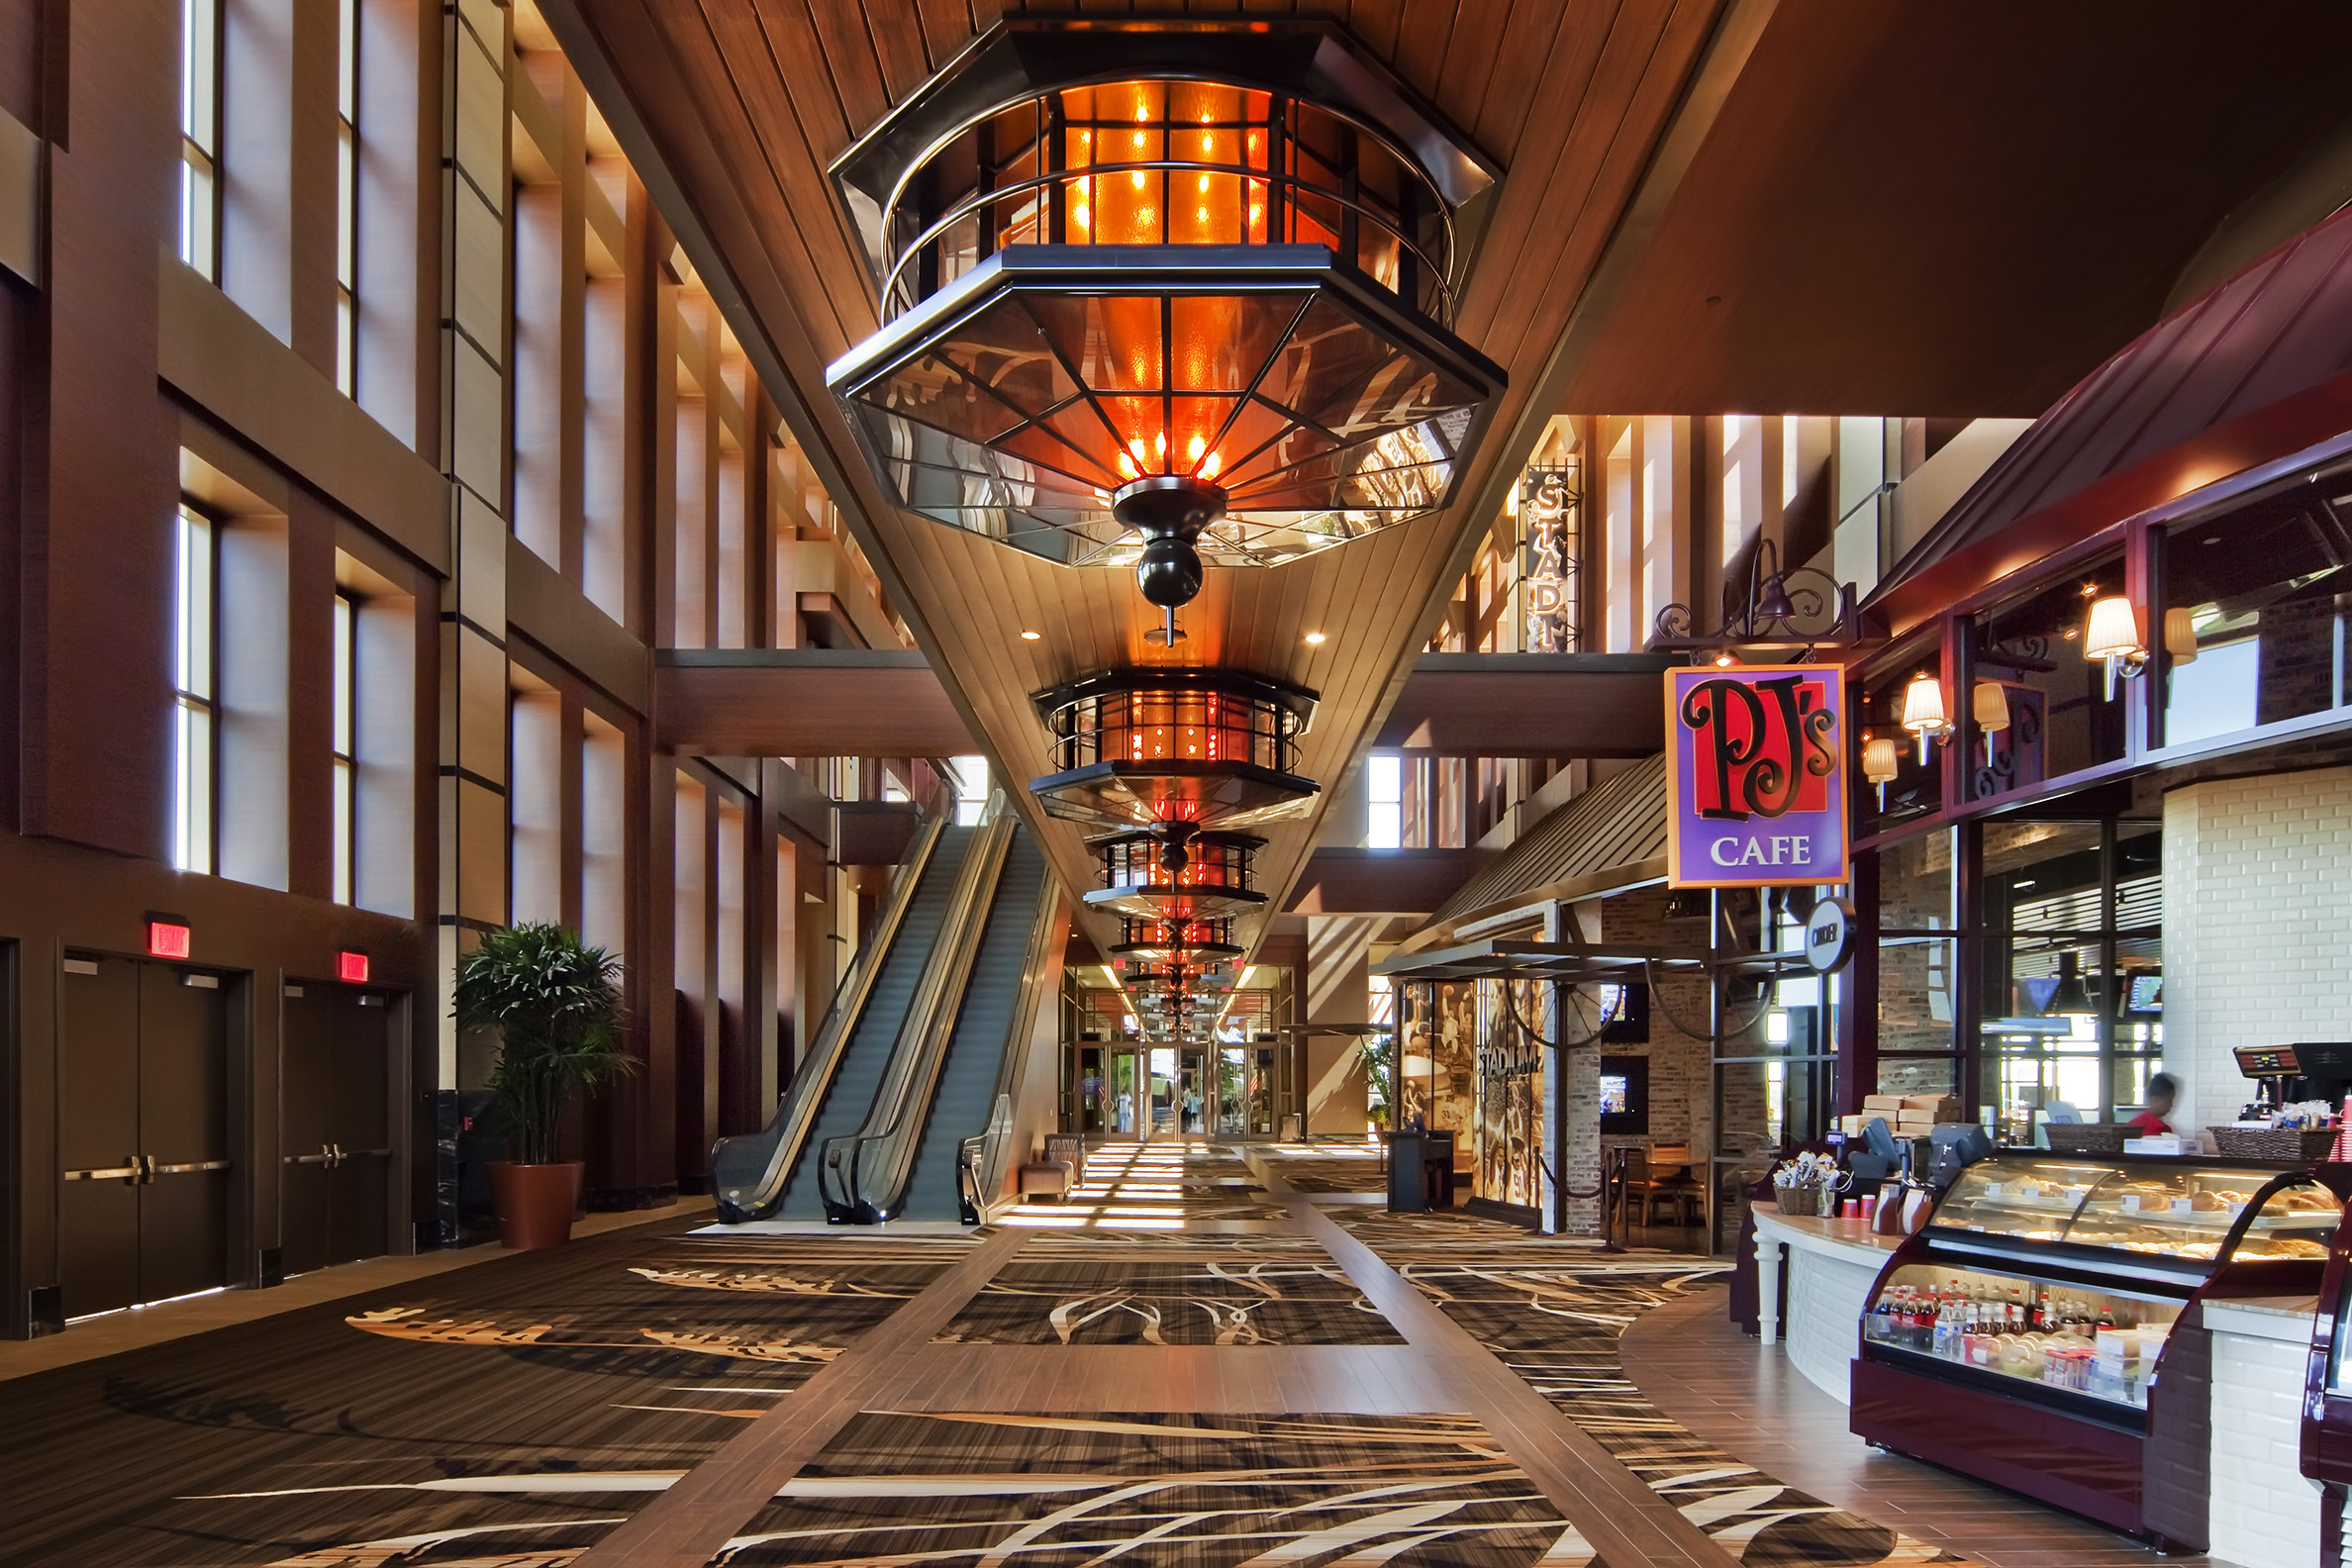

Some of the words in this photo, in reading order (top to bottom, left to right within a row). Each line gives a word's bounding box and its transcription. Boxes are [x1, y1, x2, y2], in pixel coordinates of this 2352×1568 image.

[1680, 675, 1837, 823] PJ's
[1711, 835, 1812, 867] CAFE
[158, 927, 186, 953] EXIT
[1813, 922, 1838, 948] ORDER
[1477, 1045, 1538, 1077] STADIUM
